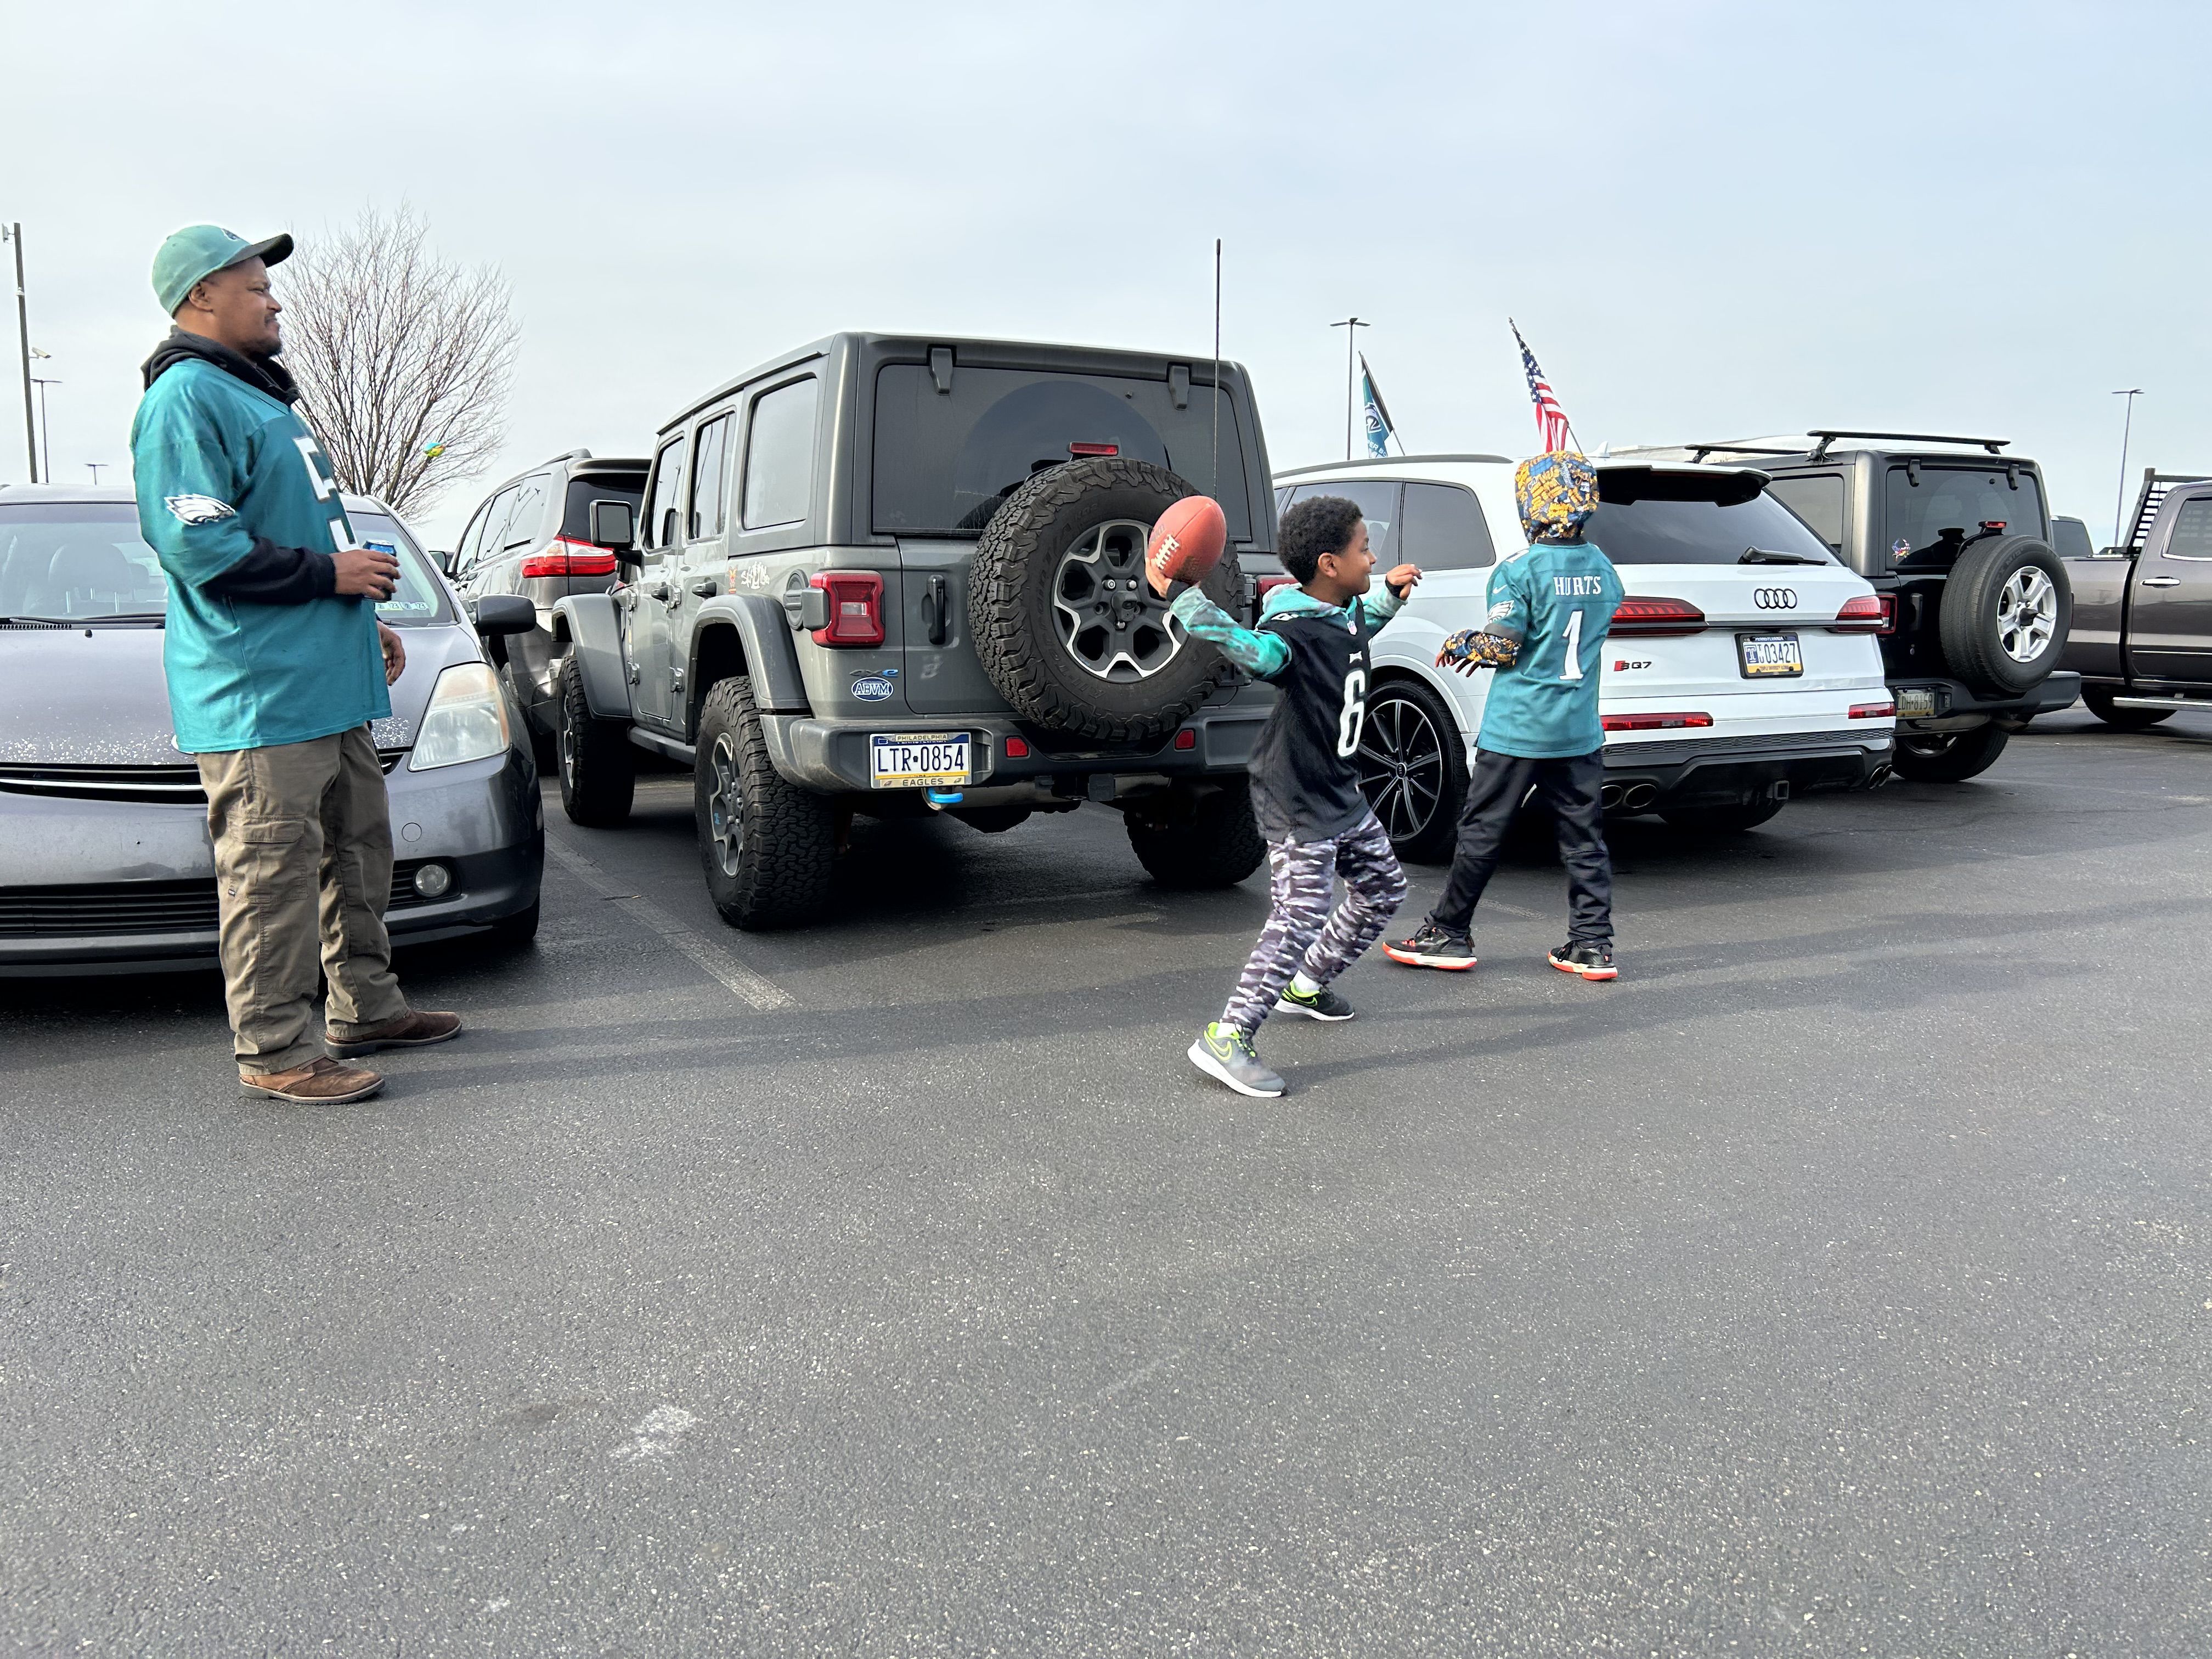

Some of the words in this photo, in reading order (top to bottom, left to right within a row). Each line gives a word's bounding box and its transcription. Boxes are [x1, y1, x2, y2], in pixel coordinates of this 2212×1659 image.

[1553, 575, 1602, 596] HURTS
[1559, 610, 1584, 680] 1
[1764, 642, 1796, 663] 03427
[855, 682, 890, 696] ABVM
[1337, 669, 1366, 757] 6
[902, 778, 944, 786] EAGLES
